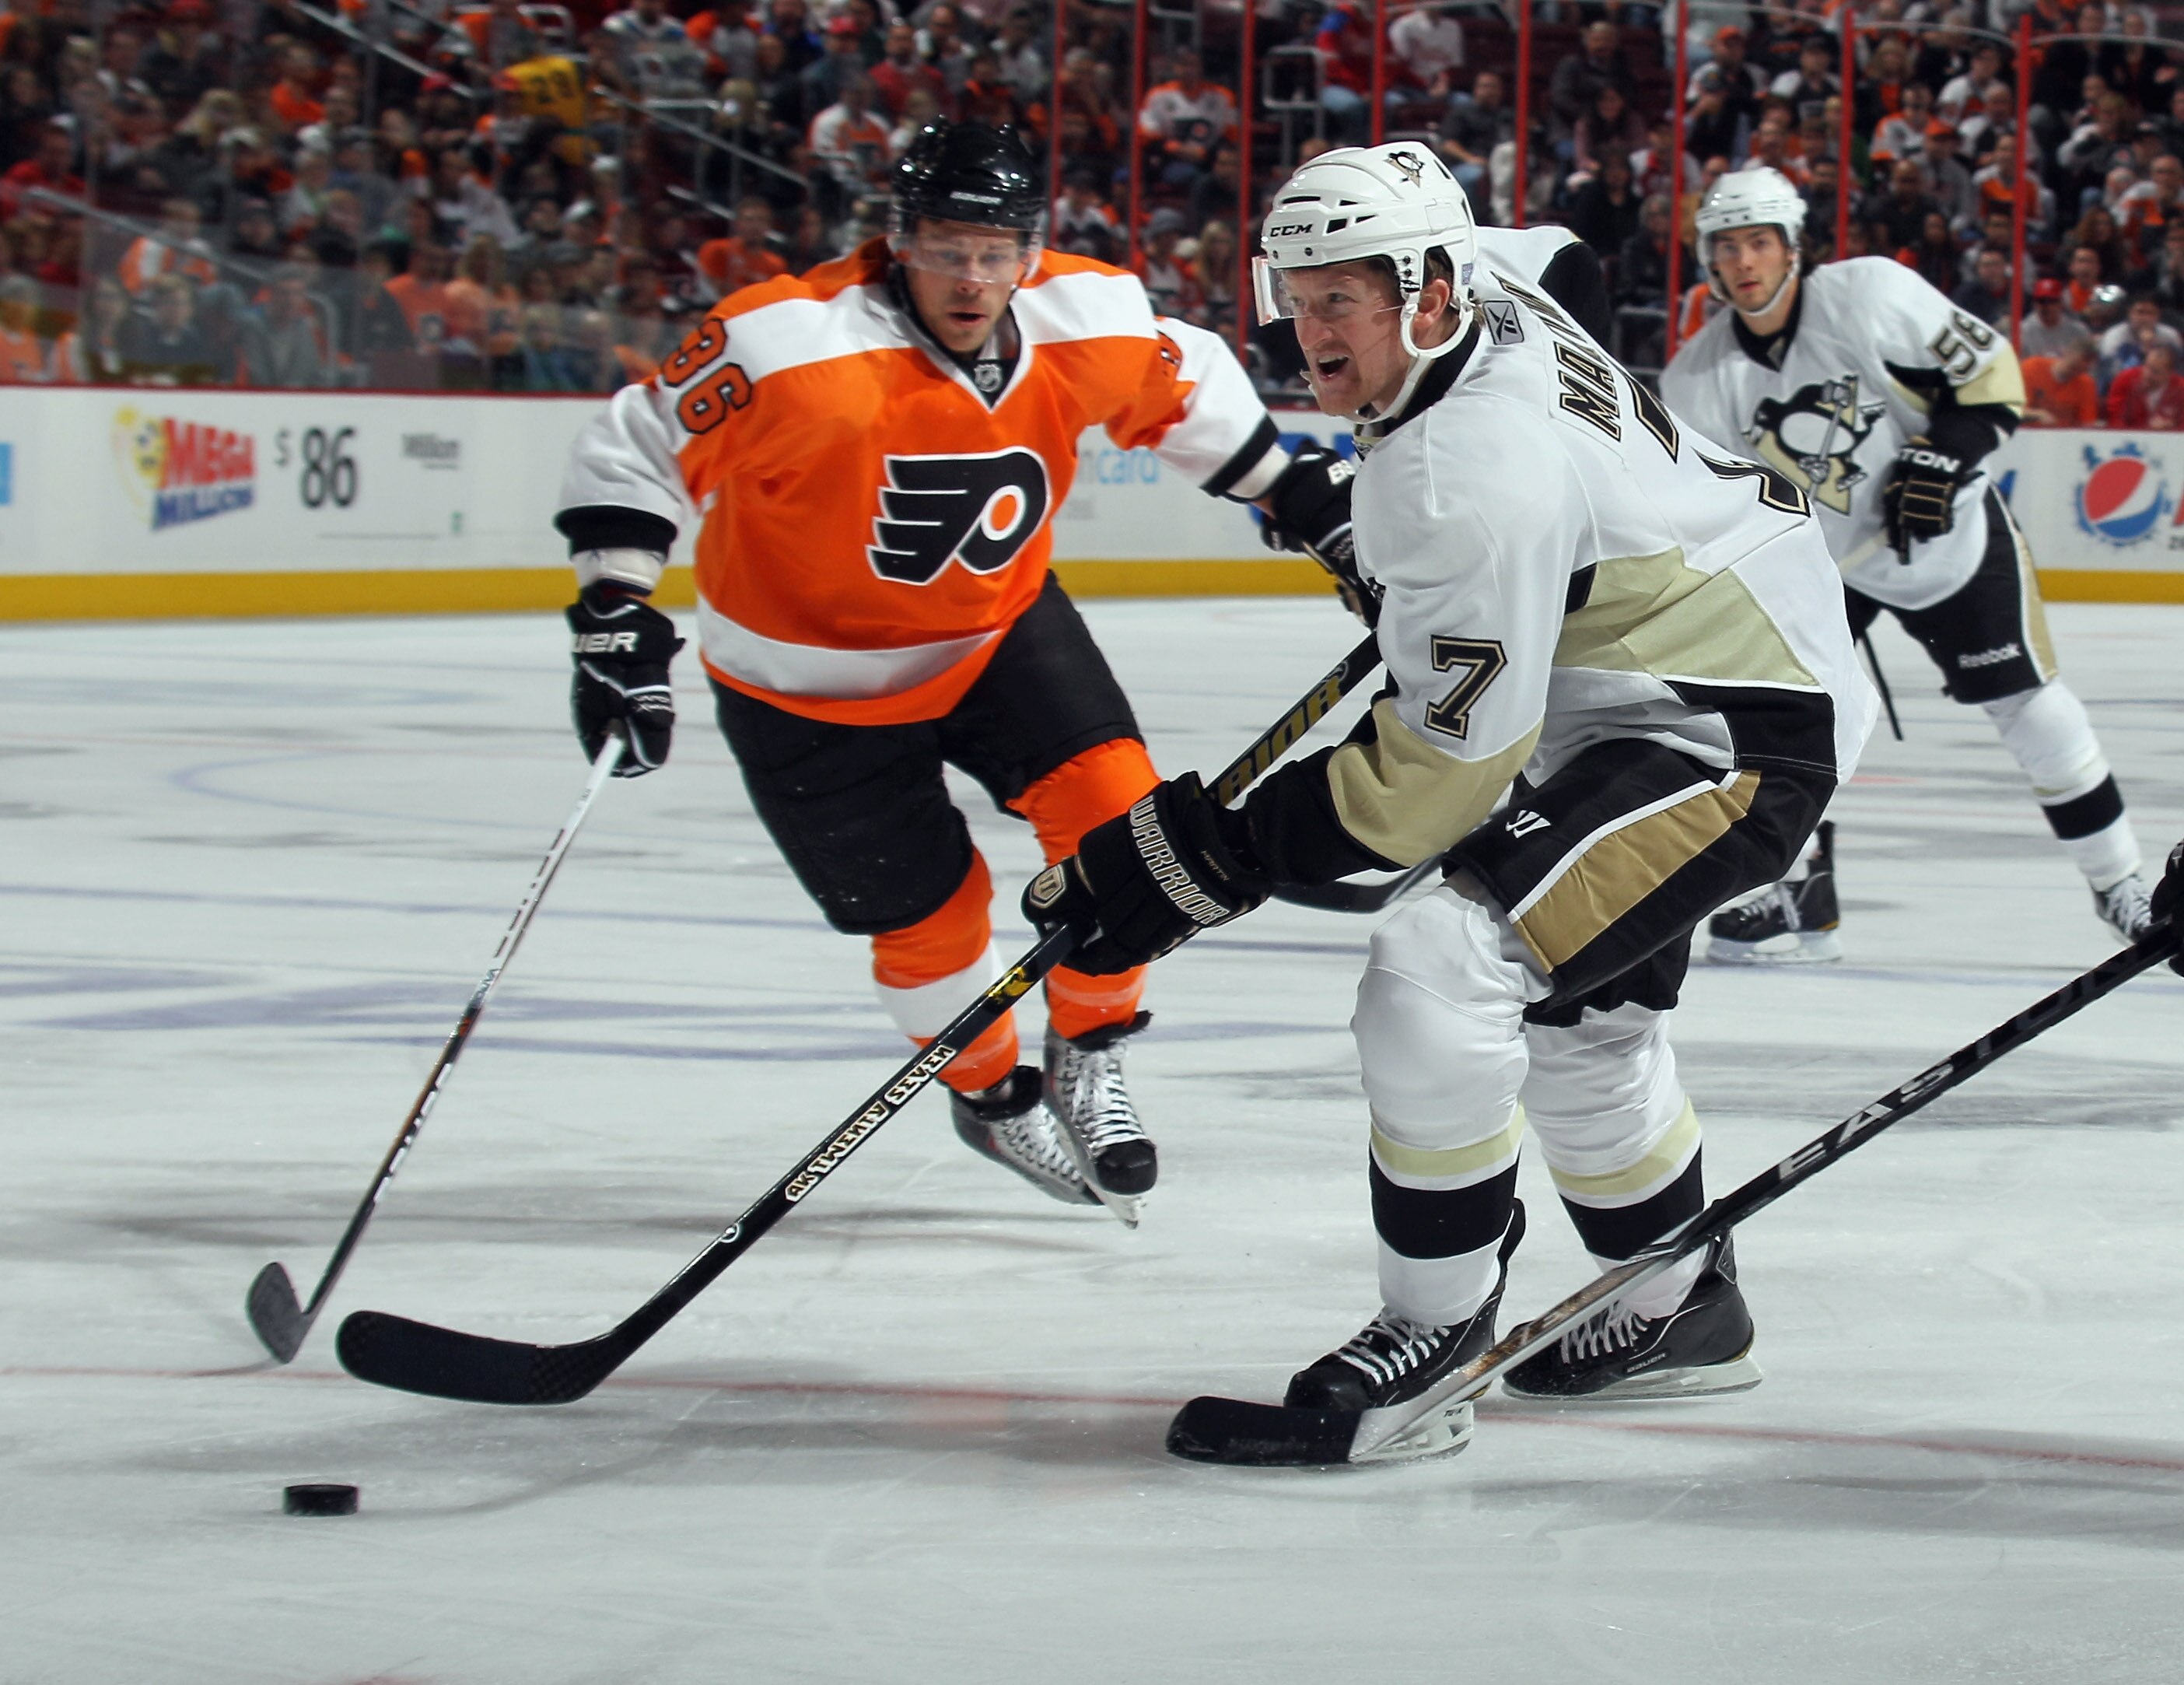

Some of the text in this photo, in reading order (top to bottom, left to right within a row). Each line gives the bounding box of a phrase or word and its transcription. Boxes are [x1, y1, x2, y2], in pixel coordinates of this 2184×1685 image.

[1269, 223, 1313, 237] CCM
[663, 317, 753, 435] 36
[158, 416, 254, 490] MEGA
[300, 426, 359, 510] 86
[1423, 634, 1508, 740] 7
[1957, 642, 2021, 669] Reebok
[1129, 793, 1230, 926] WARRIOR
[807, 1099, 890, 1174] TWENTY
[884, 1044, 957, 1106] SEVEN
[1626, 1352, 1668, 1375] BAUER
